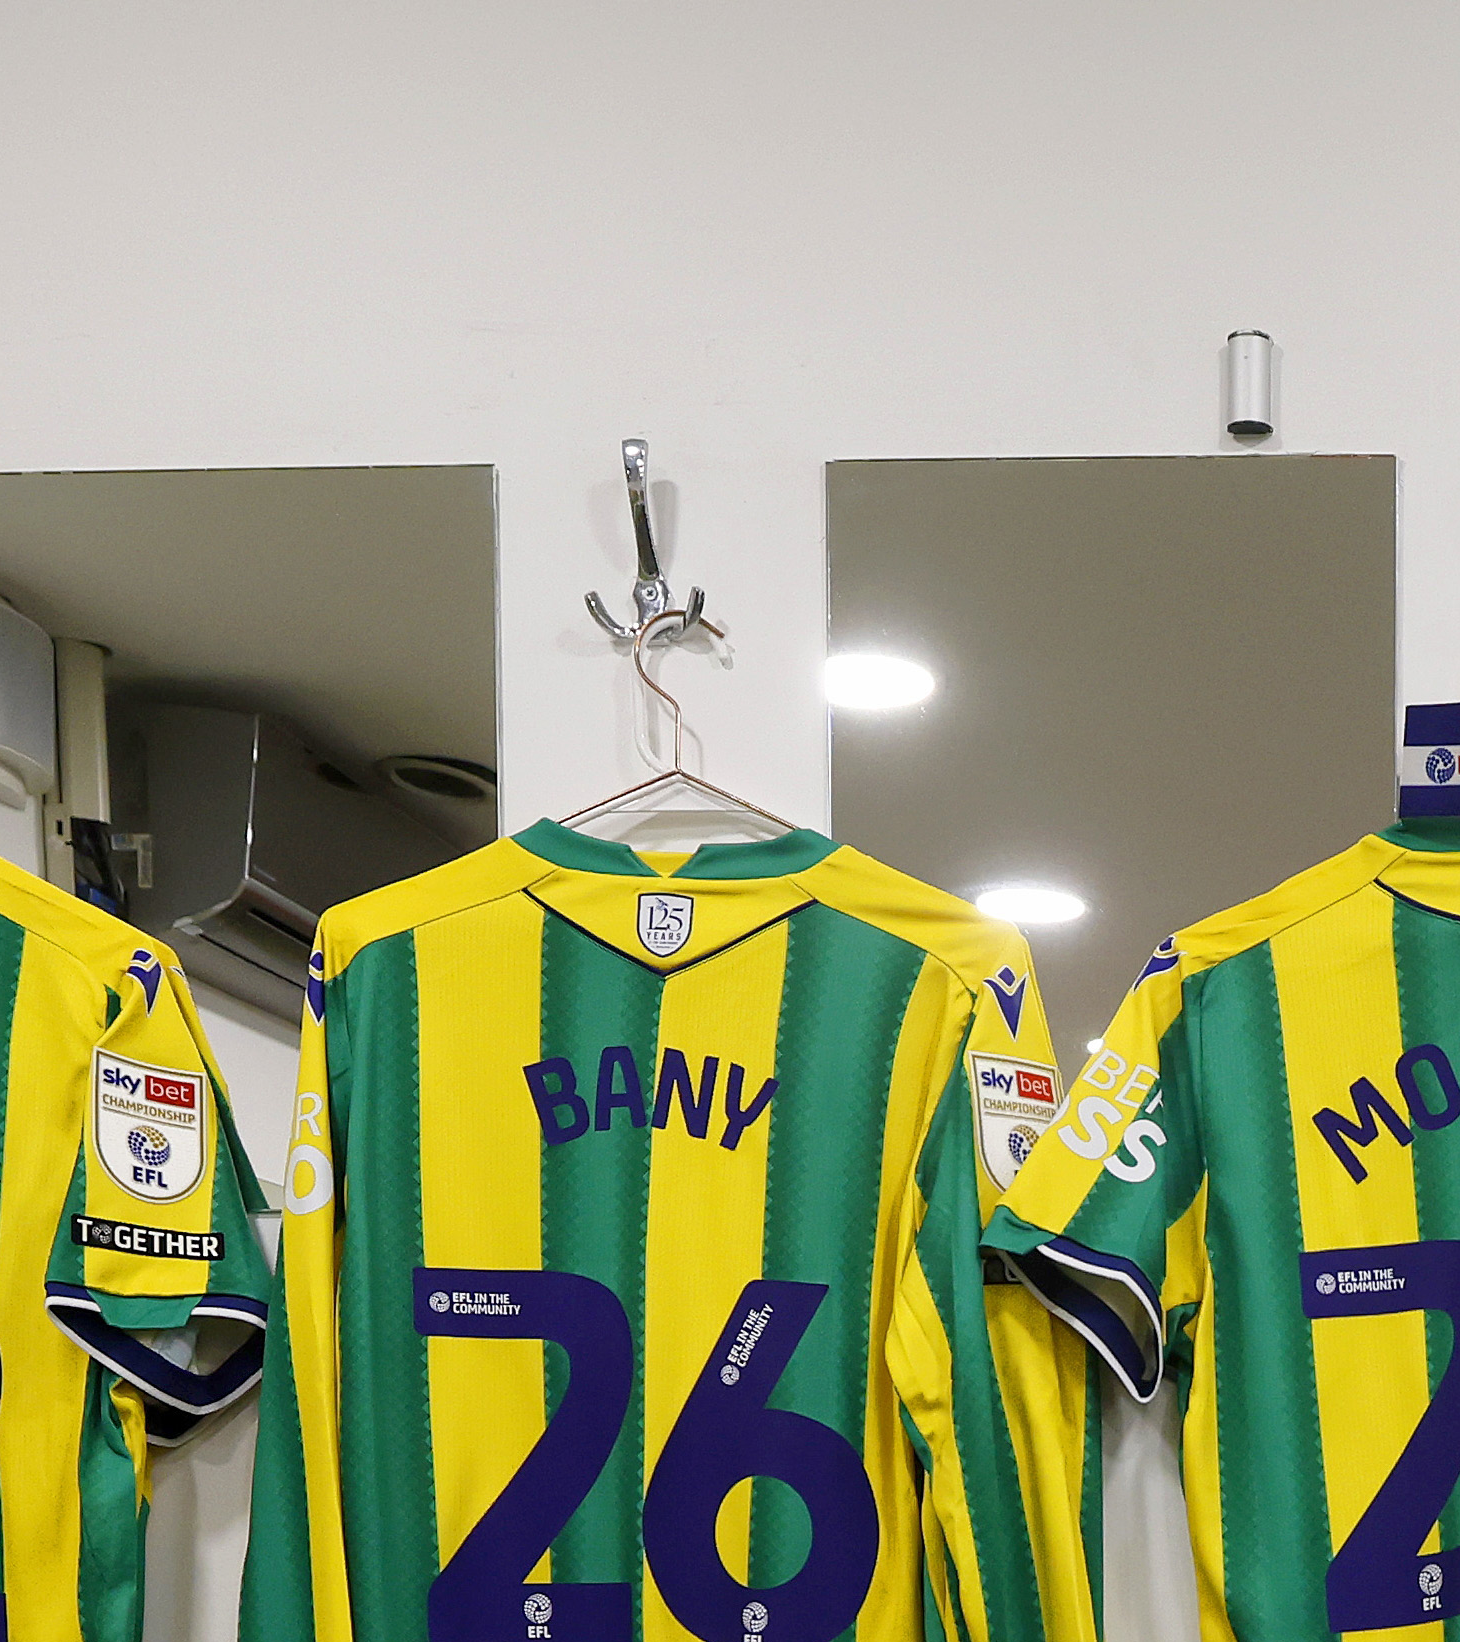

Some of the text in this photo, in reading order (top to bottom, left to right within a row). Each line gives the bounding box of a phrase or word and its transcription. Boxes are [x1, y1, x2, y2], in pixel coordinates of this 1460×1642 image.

[647, 906, 685, 931] 125
[646, 931, 682, 941] YEARS
[102, 1066, 193, 1103] sky bet
[981, 1067, 1051, 1097] sky bet
[102, 1094, 197, 1124] CHAMPIONSHIP
[523, 1045, 779, 1151] BANY
[983, 1096, 1057, 1119] CHAMPIONSHIP
[132, 1165, 170, 1189] EFL
[1337, 1268, 1394, 1283] EFL IN THE
[1338, 1278, 1405, 1294] COMMUNITY
[452, 1292, 510, 1304] EFL IN THE
[452, 1303, 521, 1315] COMMUNITY
[727, 1308, 760, 1363] EFL IN THE
[736, 1303, 774, 1367] COMMUNITY
[1422, 1596, 1442, 1611] EFL
[527, 1625, 551, 1639] EFL
